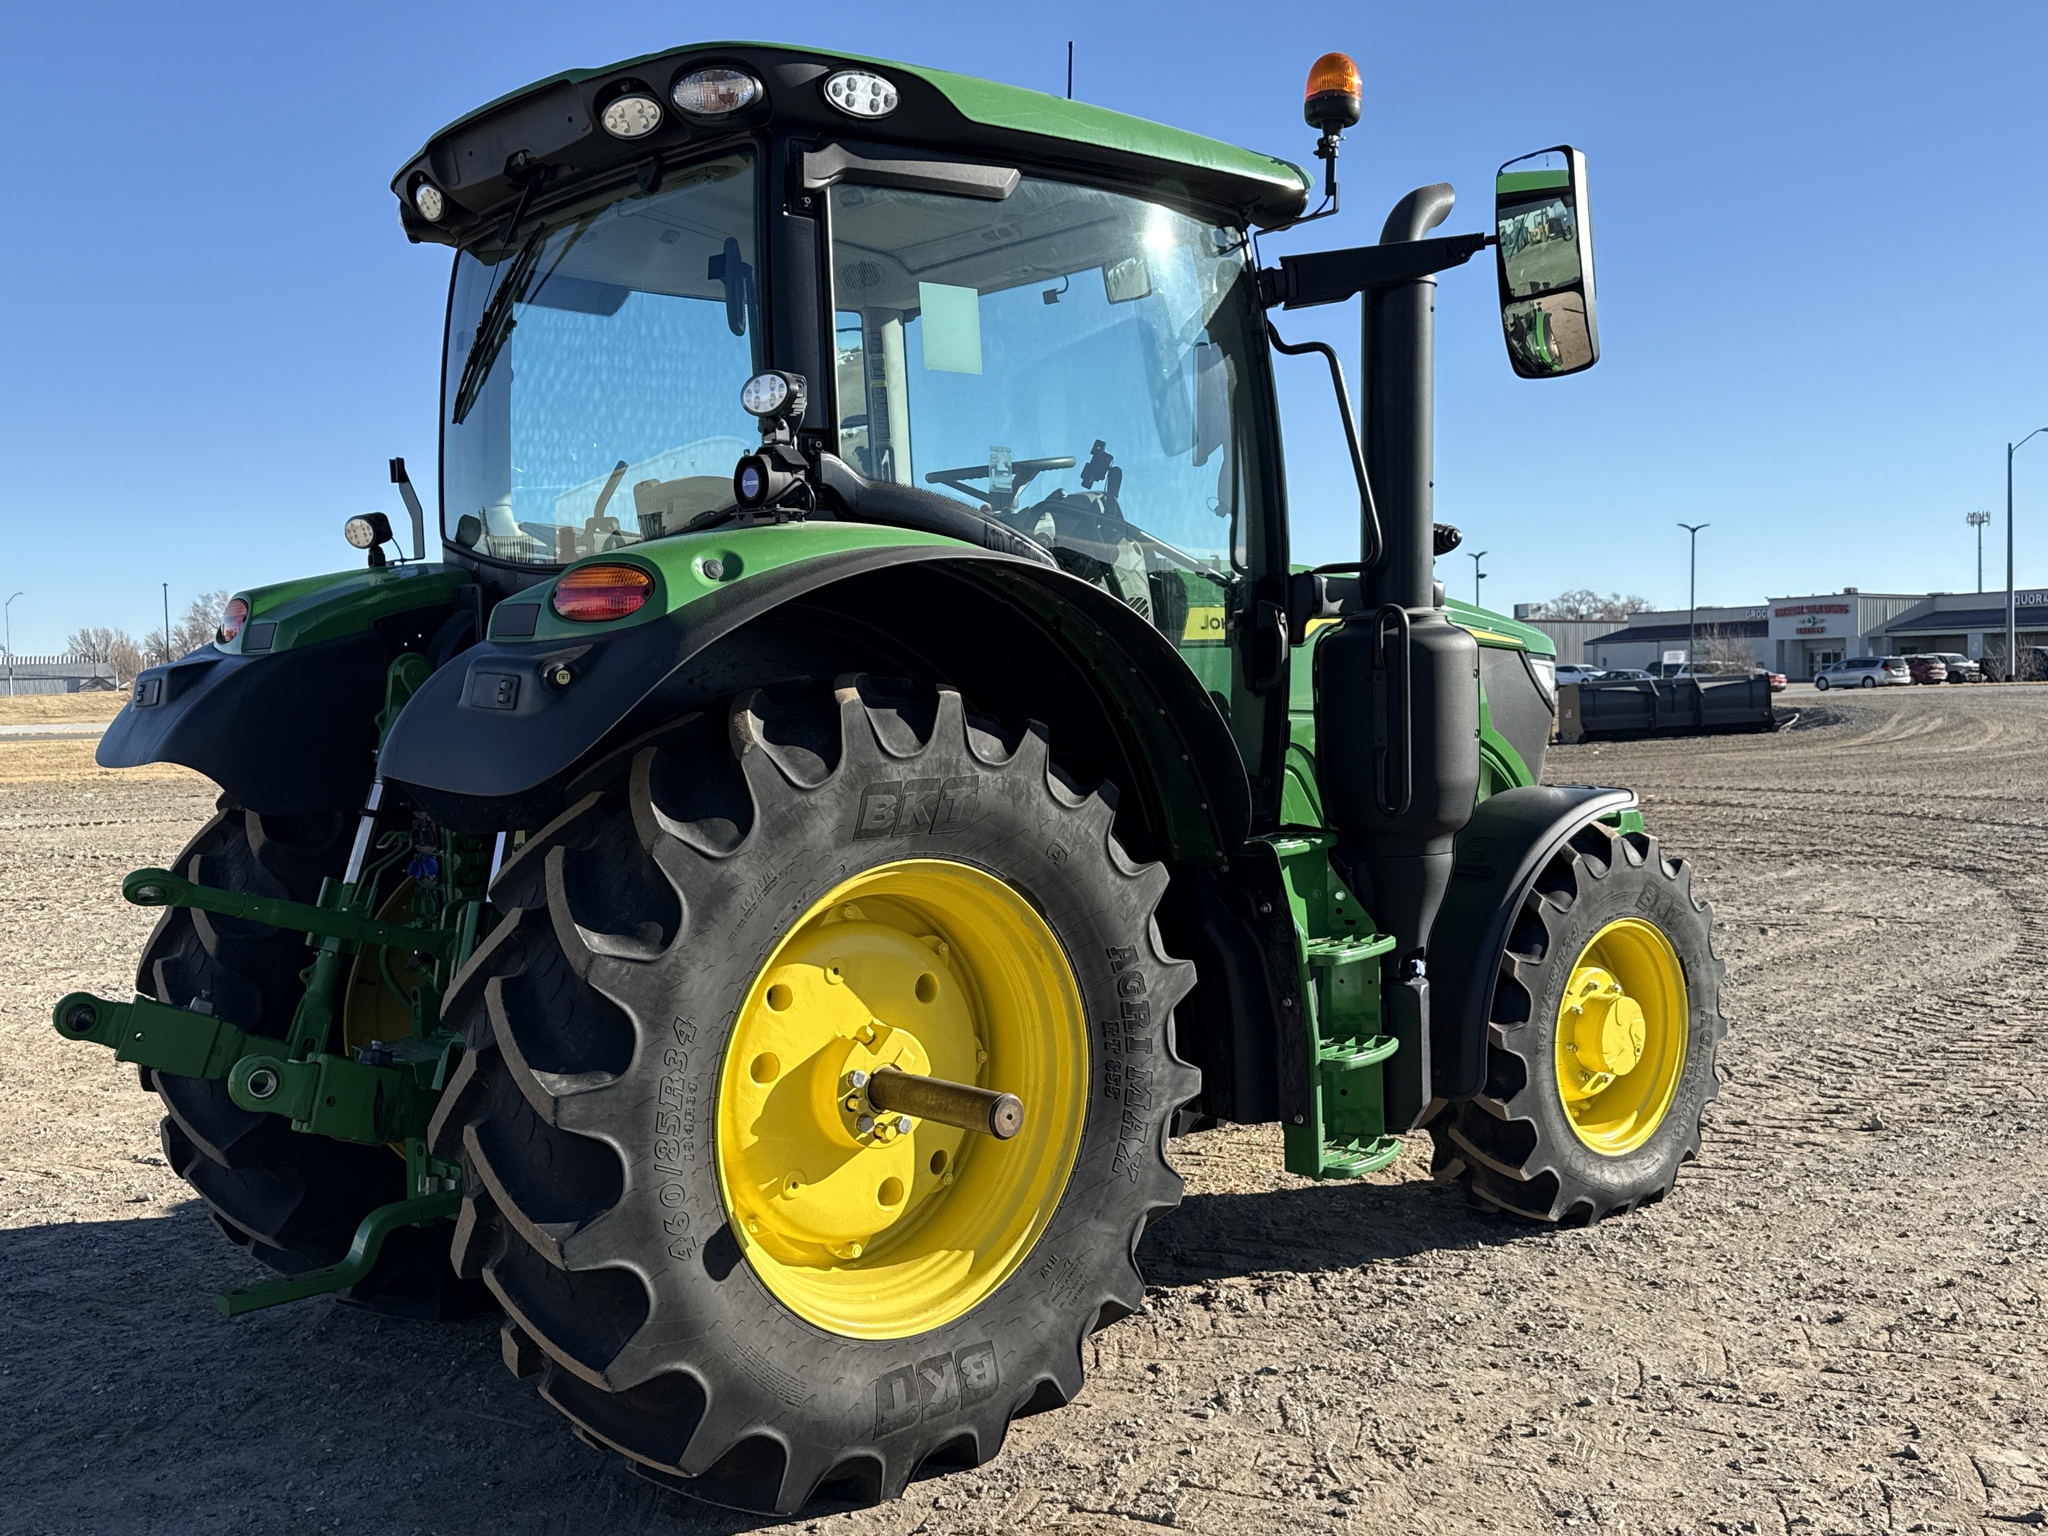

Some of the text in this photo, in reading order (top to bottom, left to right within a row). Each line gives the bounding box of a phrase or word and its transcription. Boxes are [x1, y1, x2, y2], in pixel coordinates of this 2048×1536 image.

[1745, 609, 1769, 619] GROC
[853, 775, 979, 841] BKT
[1635, 881, 1687, 932] BKT
[1102, 1019, 1121, 1099] RT 855
[1106, 944, 1152, 1184] AGRI MAX
[654, 1016, 698, 1261] 460/85R34
[873, 1340, 999, 1441] BKT
